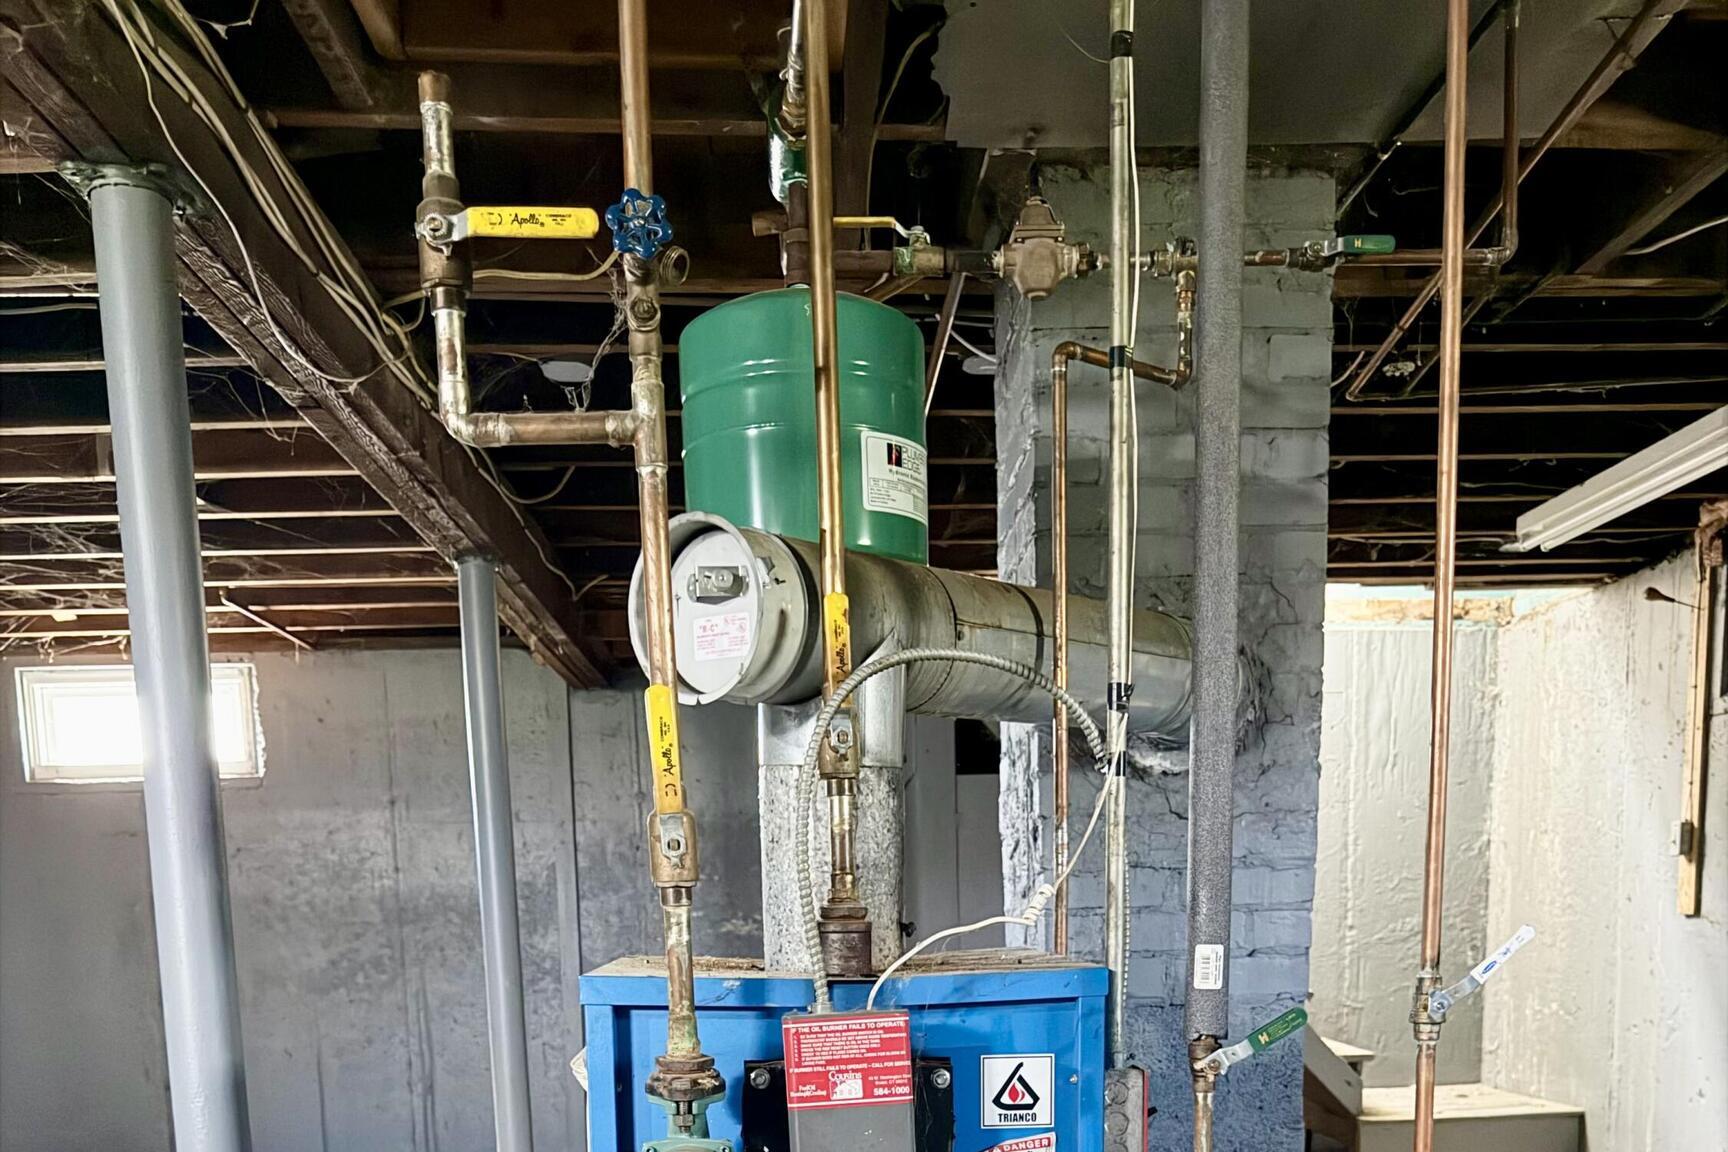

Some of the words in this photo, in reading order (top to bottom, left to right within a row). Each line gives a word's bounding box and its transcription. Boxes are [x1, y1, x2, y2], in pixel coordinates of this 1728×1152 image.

[1258, 1031, 1270, 1045] H
[828, 1070, 863, 1081] Cousins
[873, 1086, 910, 1096] 584-1000
[998, 1112, 1037, 1123] TRIANCO
[1002, 1138, 1049, 1152] DANGER
